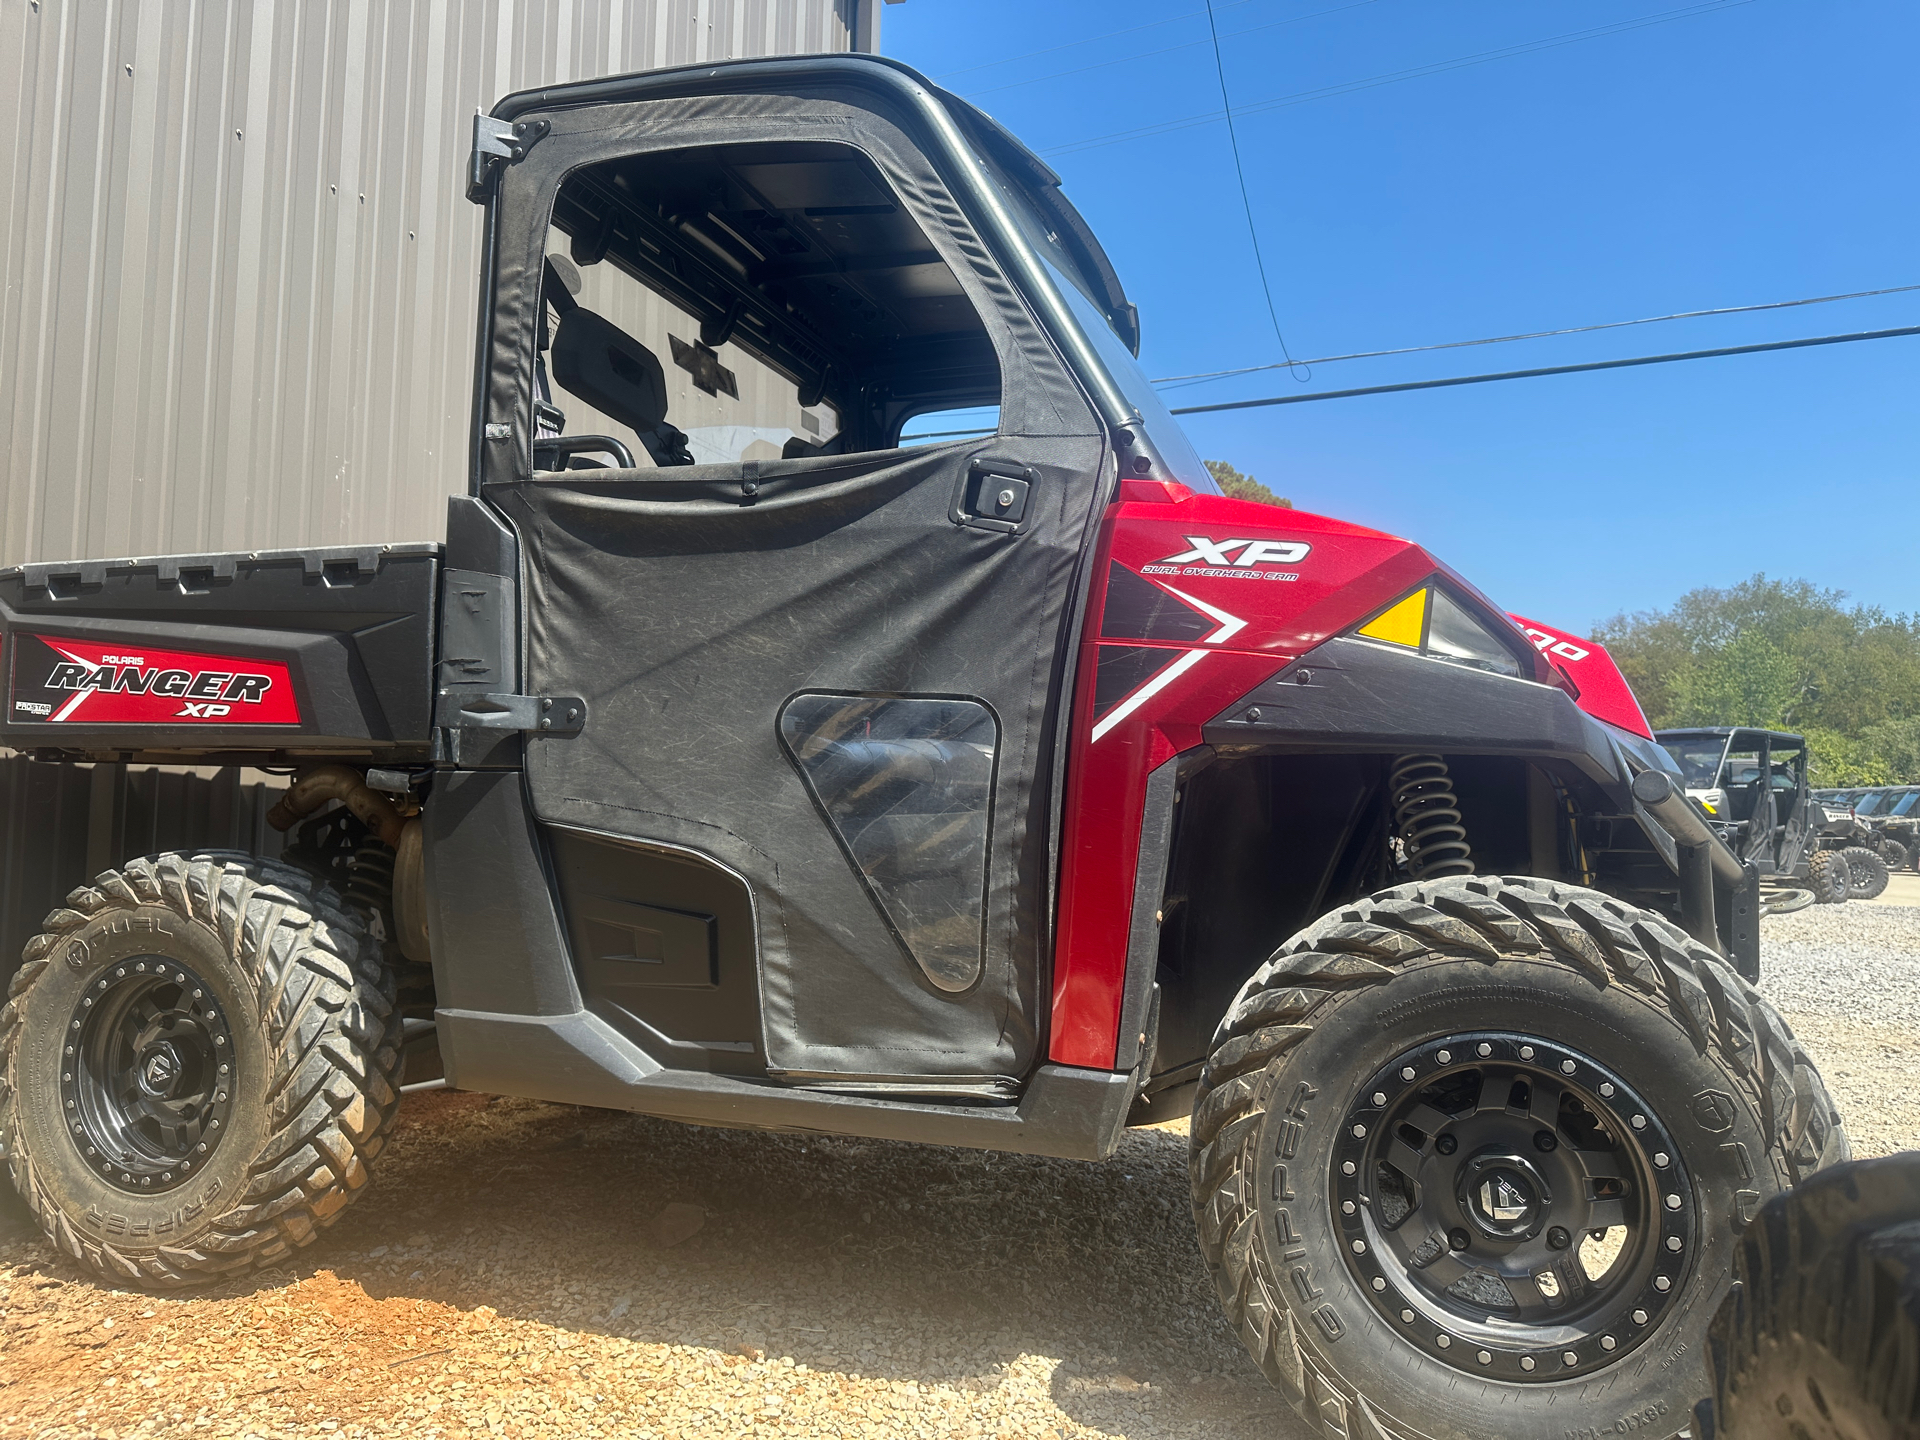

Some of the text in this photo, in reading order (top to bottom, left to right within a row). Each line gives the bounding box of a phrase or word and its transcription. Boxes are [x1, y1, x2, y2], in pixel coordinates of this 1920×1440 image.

[1155, 535, 1312, 567] XP
[1140, 565, 1300, 582] DUAL OVERHEAD CAM
[102, 655, 144, 665] POLARIS
[45, 662, 271, 703] RANGER
[174, 701, 231, 718] XP
[1496, 1176, 1527, 1204] FUEL
[86, 1176, 224, 1237] GRIPPER
[1272, 1081, 1347, 1344] GRIPPER
